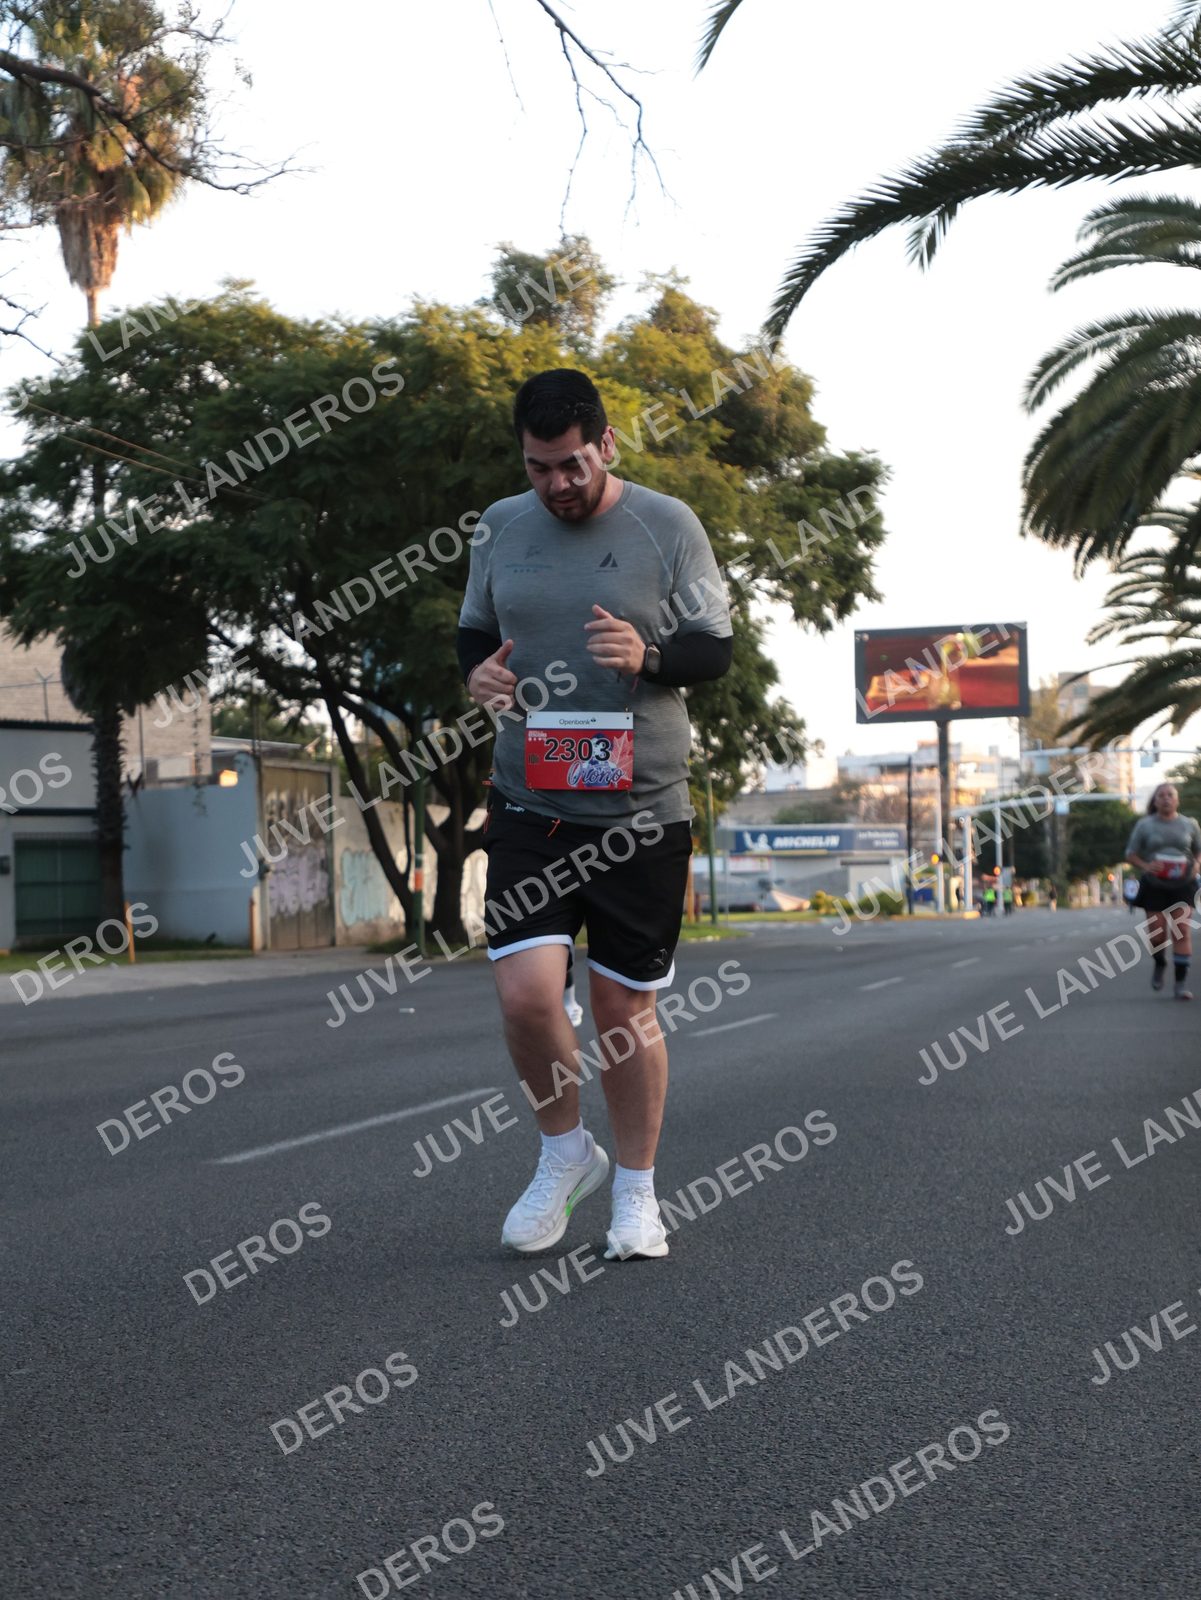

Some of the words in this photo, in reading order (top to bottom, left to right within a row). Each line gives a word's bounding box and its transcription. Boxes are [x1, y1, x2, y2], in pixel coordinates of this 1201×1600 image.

[558, 718, 590, 727] Openbank
[544, 737, 611, 762] 2303
[773, 835, 840, 848] MICHELIN
